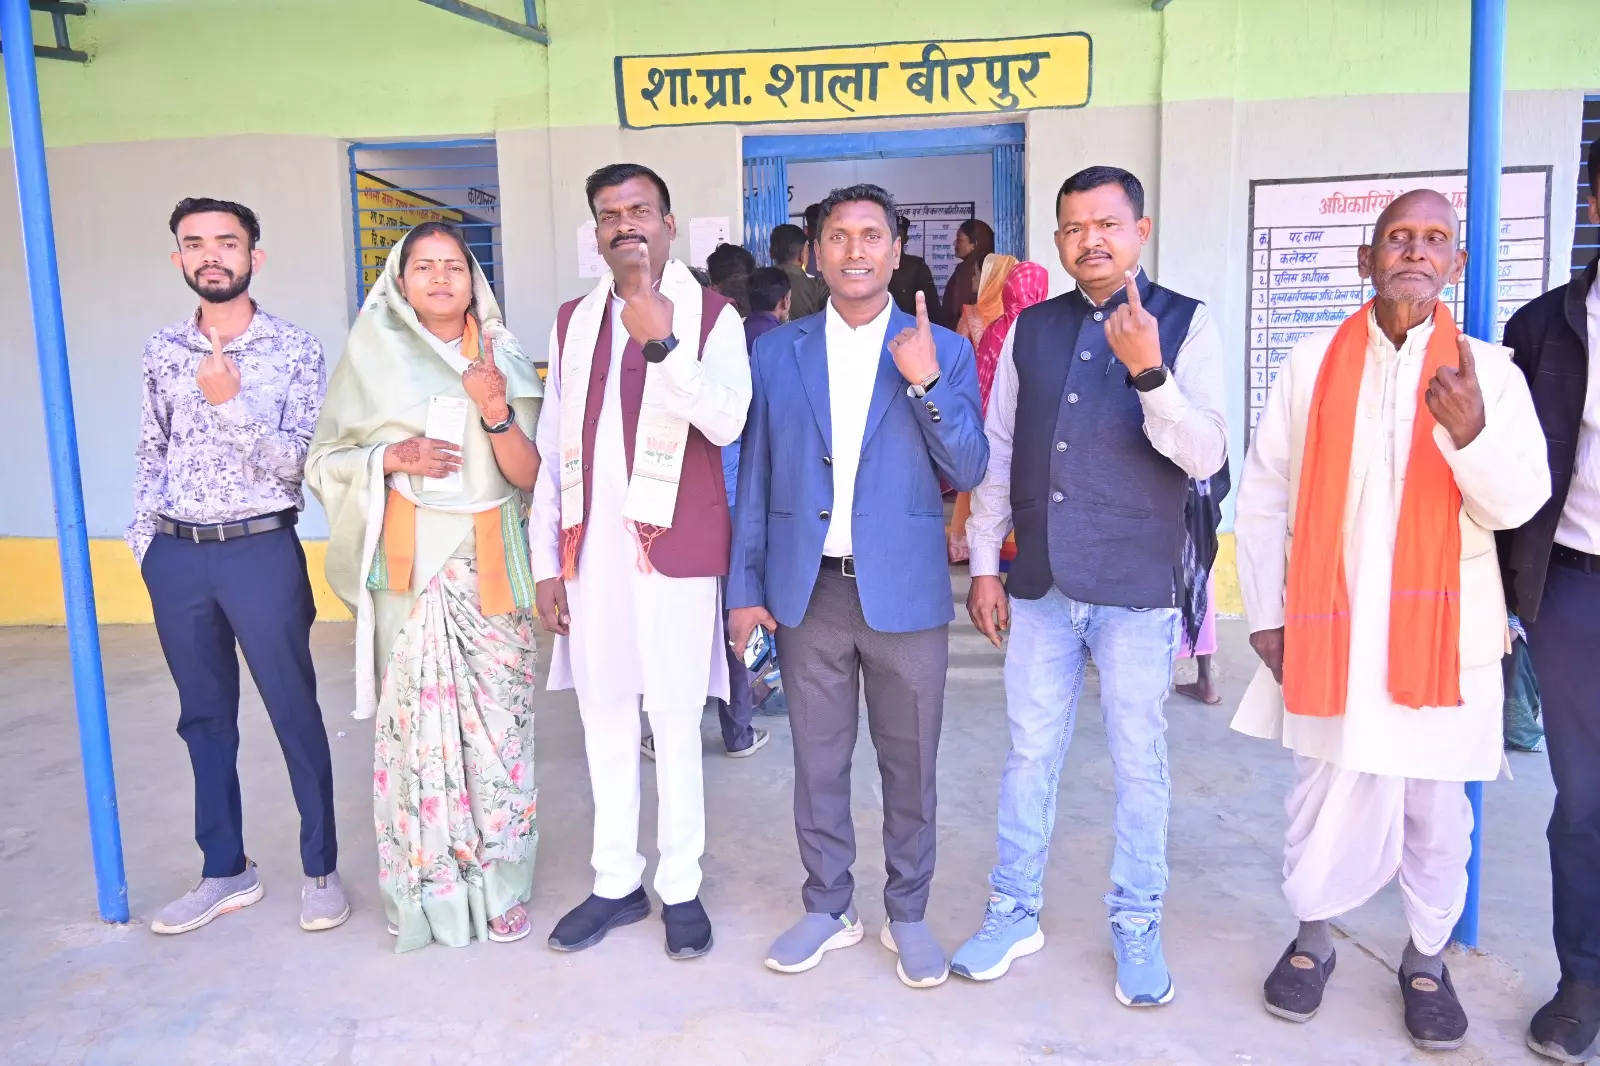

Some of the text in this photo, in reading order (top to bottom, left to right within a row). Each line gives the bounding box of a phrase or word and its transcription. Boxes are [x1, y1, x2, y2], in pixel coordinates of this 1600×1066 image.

[765, 61, 888, 112] शाला
[900, 44, 1050, 112] बीरपुर
[1289, 233, 1303, 244] पद
[1304, 232, 1325, 243] नाम
[1280, 251, 1320, 265] कलेक्टर
[1274, 271, 1299, 287] पुलिस
[1271, 310, 1293, 324] जिला
[1293, 310, 1315, 324] शिक्षा
